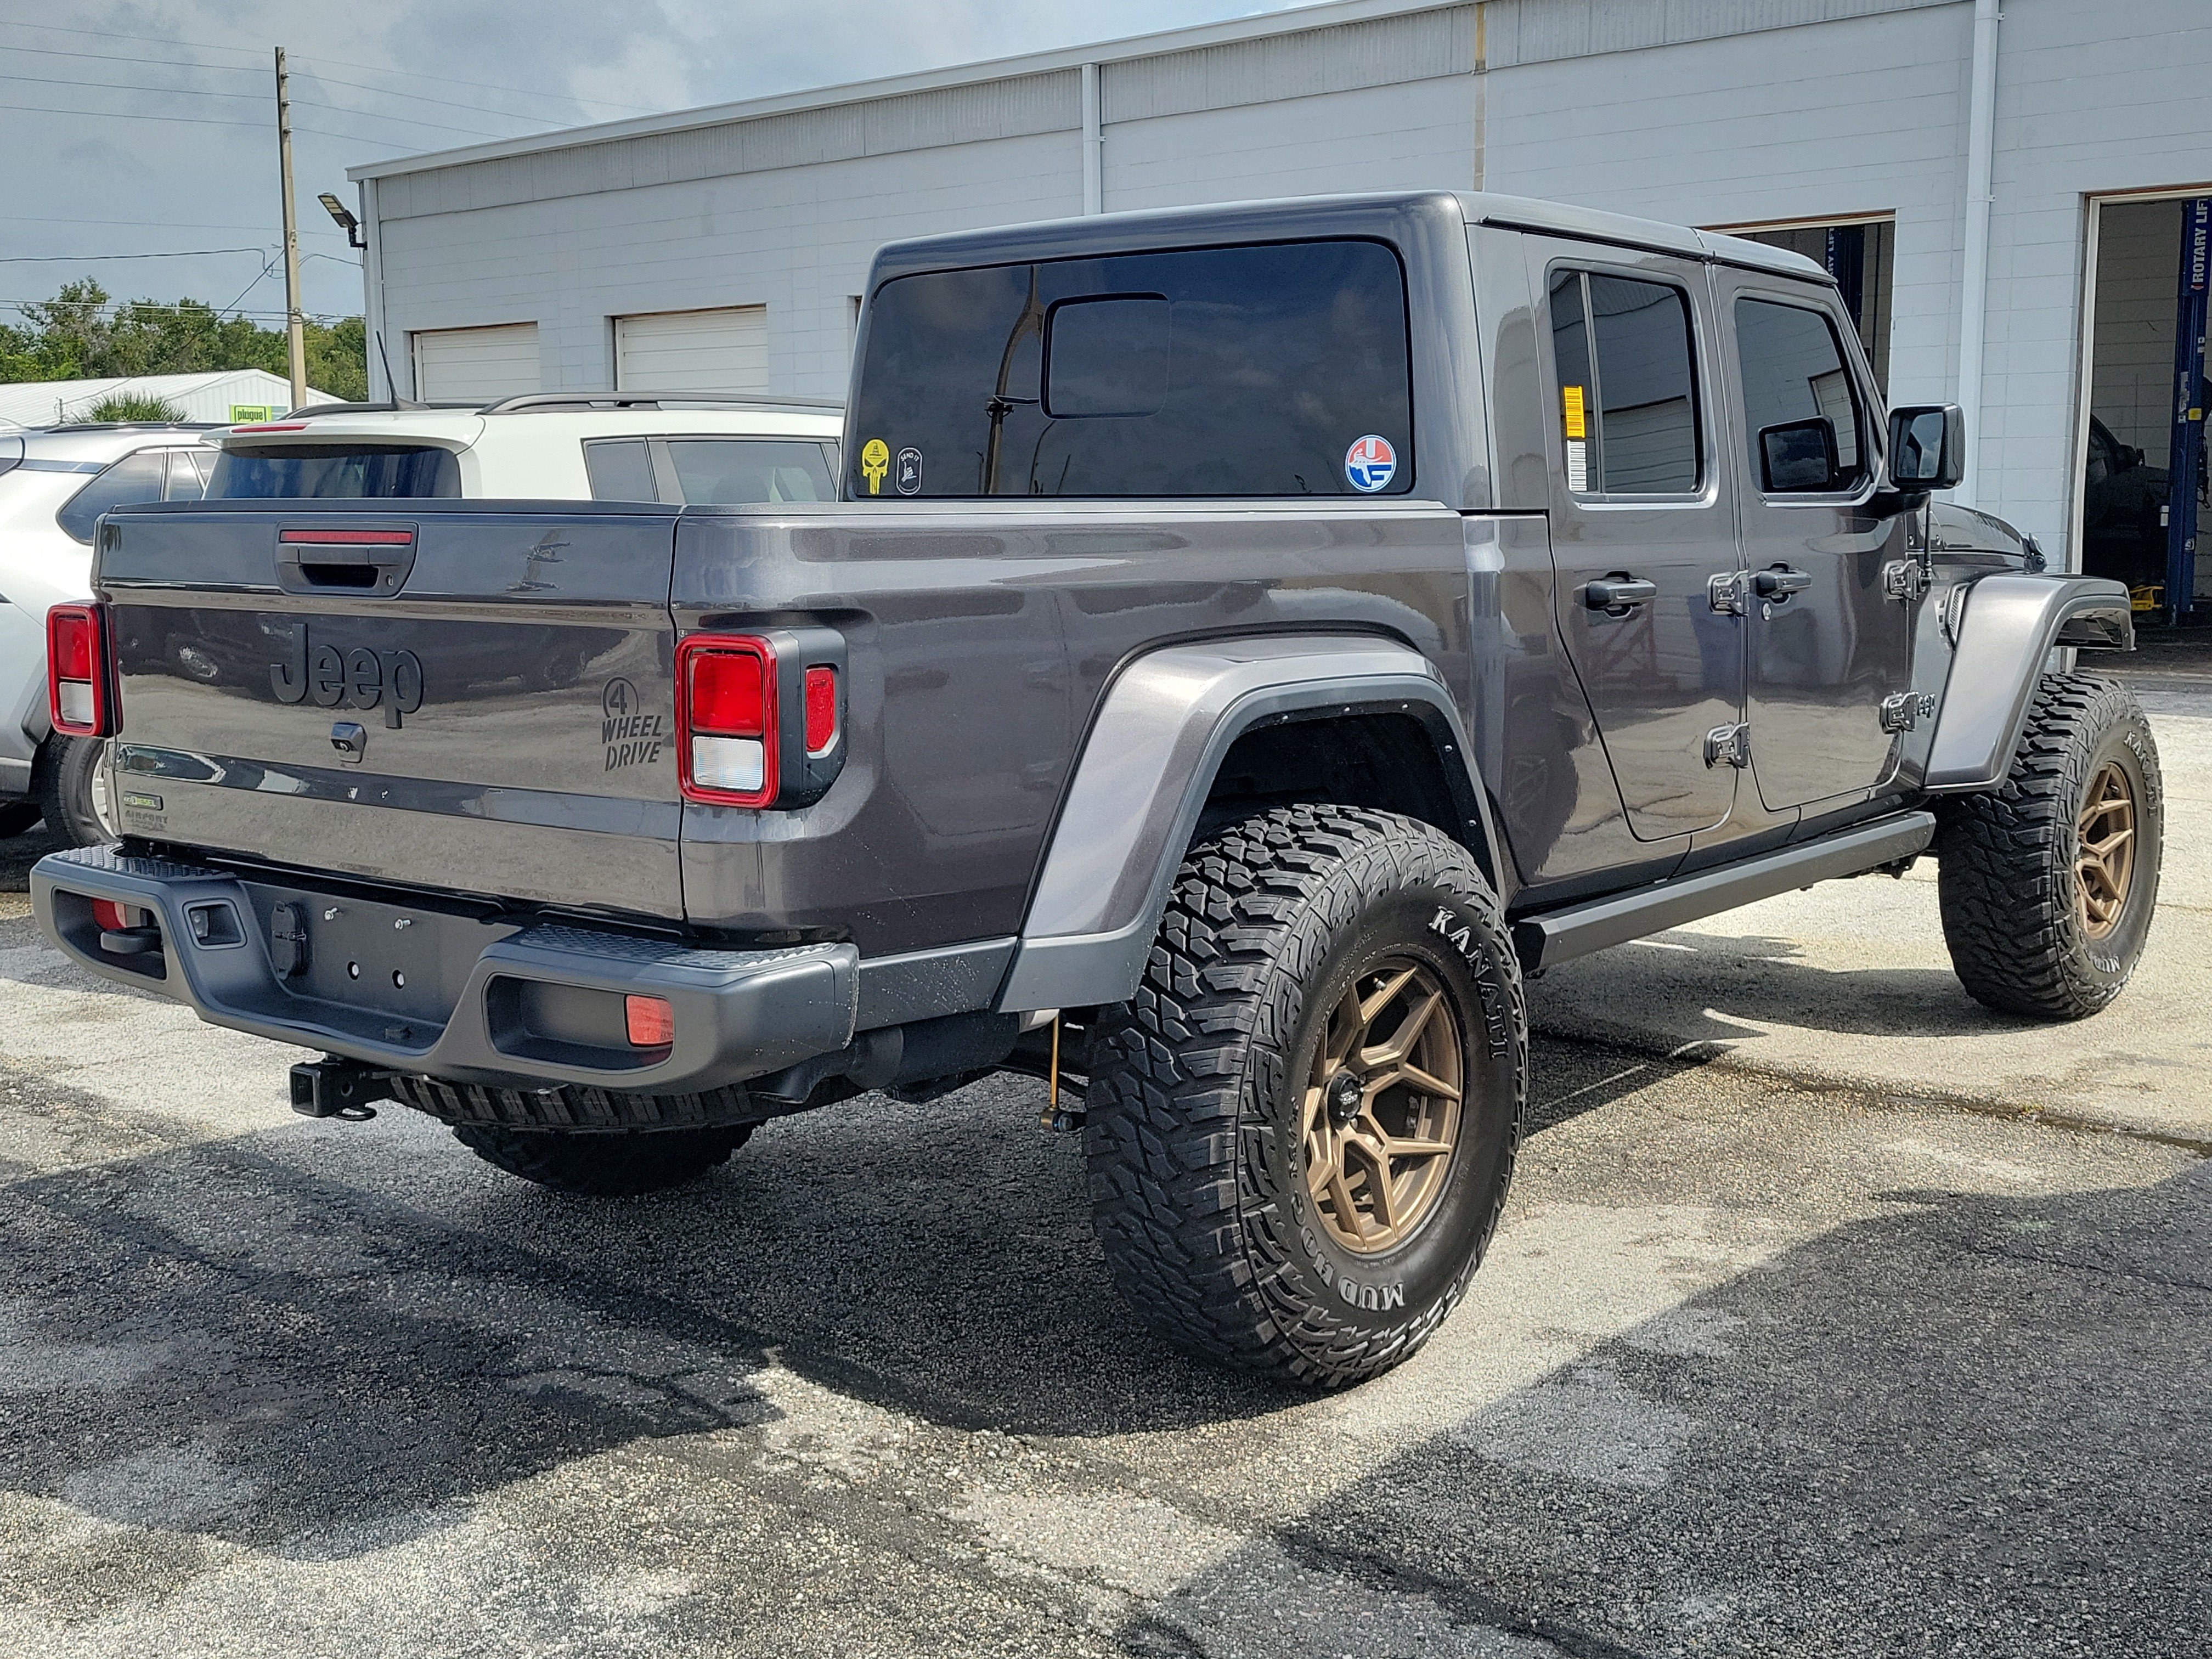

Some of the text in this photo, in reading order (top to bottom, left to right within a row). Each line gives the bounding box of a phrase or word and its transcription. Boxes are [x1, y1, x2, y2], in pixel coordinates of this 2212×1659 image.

[2192, 228, 2207, 283] ROTARY
[900, 453, 914, 461] SEND
[270, 623, 424, 730] Jeep
[609, 683, 627, 714] 4
[602, 715, 662, 744] WHEEL
[605, 742, 662, 771] DRIVE
[1427, 905, 1510, 1060] KANATI
[1291, 1189, 1336, 1288] HOG
[1338, 1276, 1406, 1312] MUD
